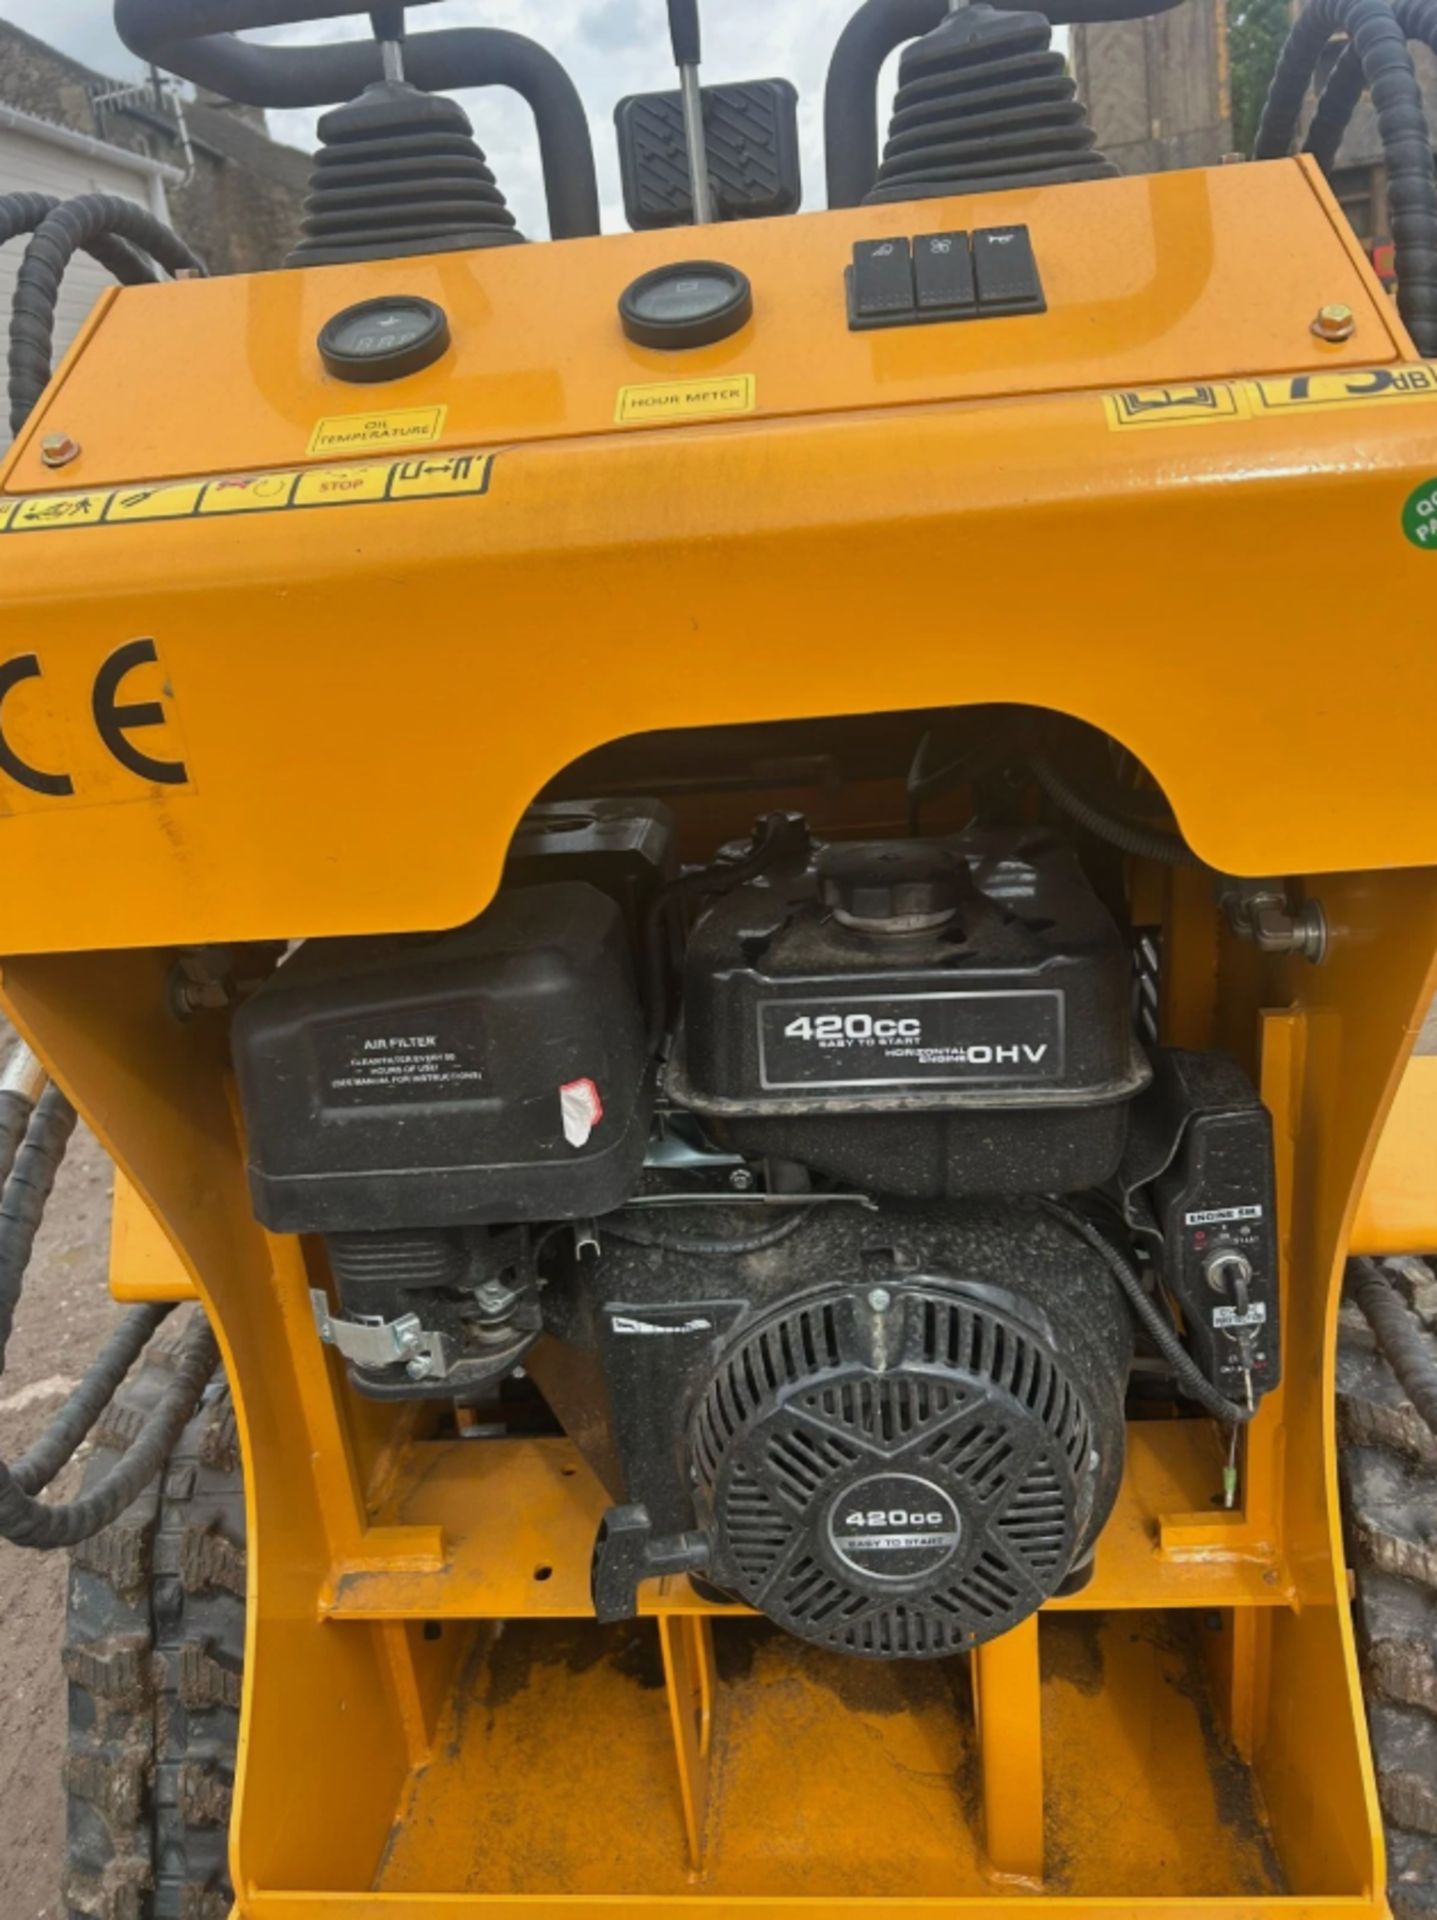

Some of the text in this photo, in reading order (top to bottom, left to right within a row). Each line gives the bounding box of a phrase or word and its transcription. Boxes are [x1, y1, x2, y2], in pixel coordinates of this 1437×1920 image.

[631, 389, 741, 408] HOUR METER
[364, 420, 388, 430] OIL
[320, 425, 430, 445] TEMPERATURE
[319, 479, 364, 492] STOP
[784, 1014, 921, 1040] 420cc
[364, 1035, 437, 1050] AIR FILTER
[818, 1036, 921, 1048] EASY TO START
[884, 1047, 966, 1057] HORIZONTAL
[918, 1054, 966, 1063] ENGINE
[966, 1044, 1048, 1064] OHV
[1189, 1209, 1234, 1223] ENGINE
[846, 1509, 943, 1527] 420cc
[847, 1535, 944, 1548] EASY TO START
